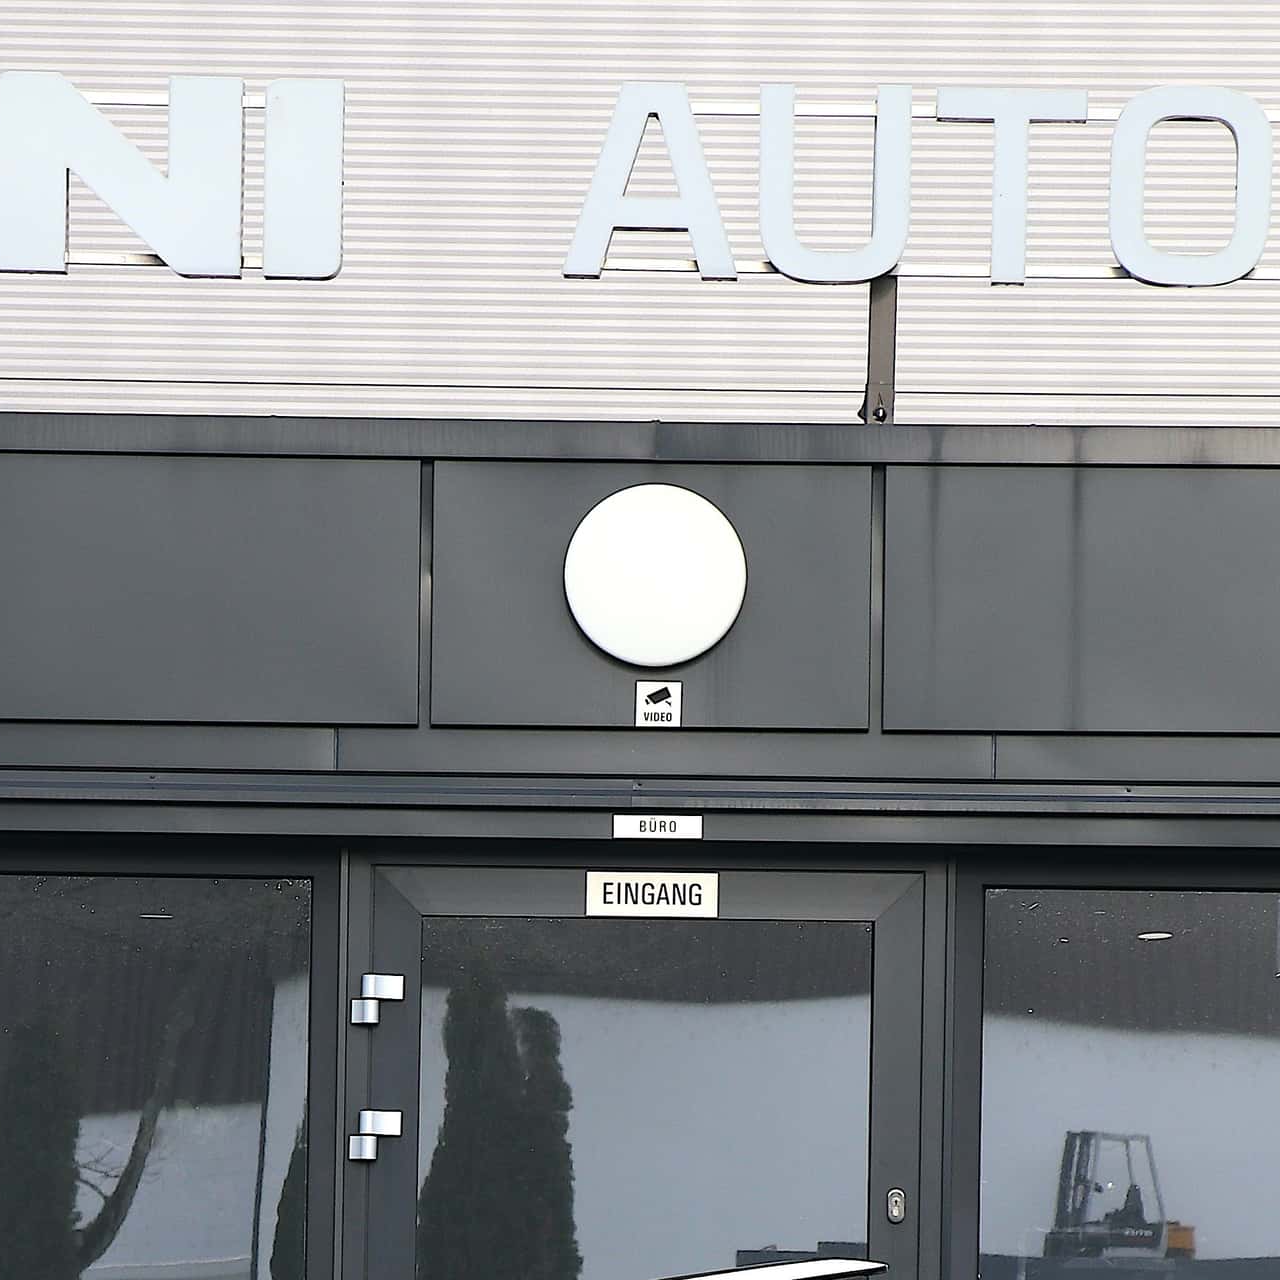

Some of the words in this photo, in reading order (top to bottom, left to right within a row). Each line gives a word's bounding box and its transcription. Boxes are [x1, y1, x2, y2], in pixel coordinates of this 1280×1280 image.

[561, 80, 1273, 289] AUTO
[643, 711, 673, 722] VIDEO
[639, 817, 677, 833] BÜRO
[602, 882, 703, 906] EINGANG
